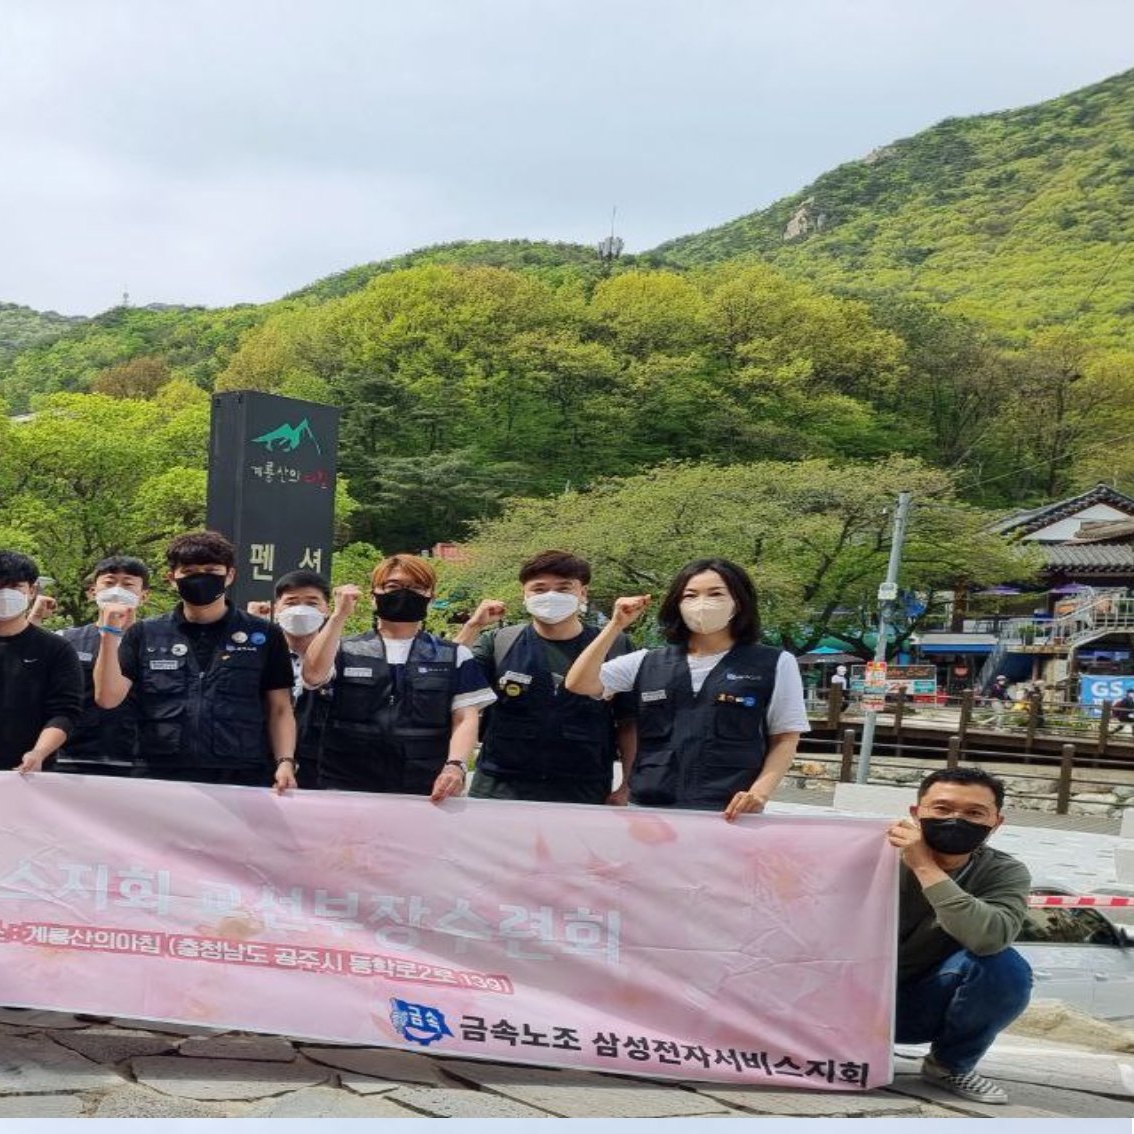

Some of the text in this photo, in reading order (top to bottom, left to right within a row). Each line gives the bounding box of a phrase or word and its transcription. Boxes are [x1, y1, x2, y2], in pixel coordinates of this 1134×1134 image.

[24, 924, 161, 955] 계룡산의아침
[168, 937, 269, 963] (충청남도
[274, 947, 342, 973] 공주시
[459, 1014, 582, 1050] 금속노조
[592, 1031, 870, 1087] 삼성전자서비스지회
